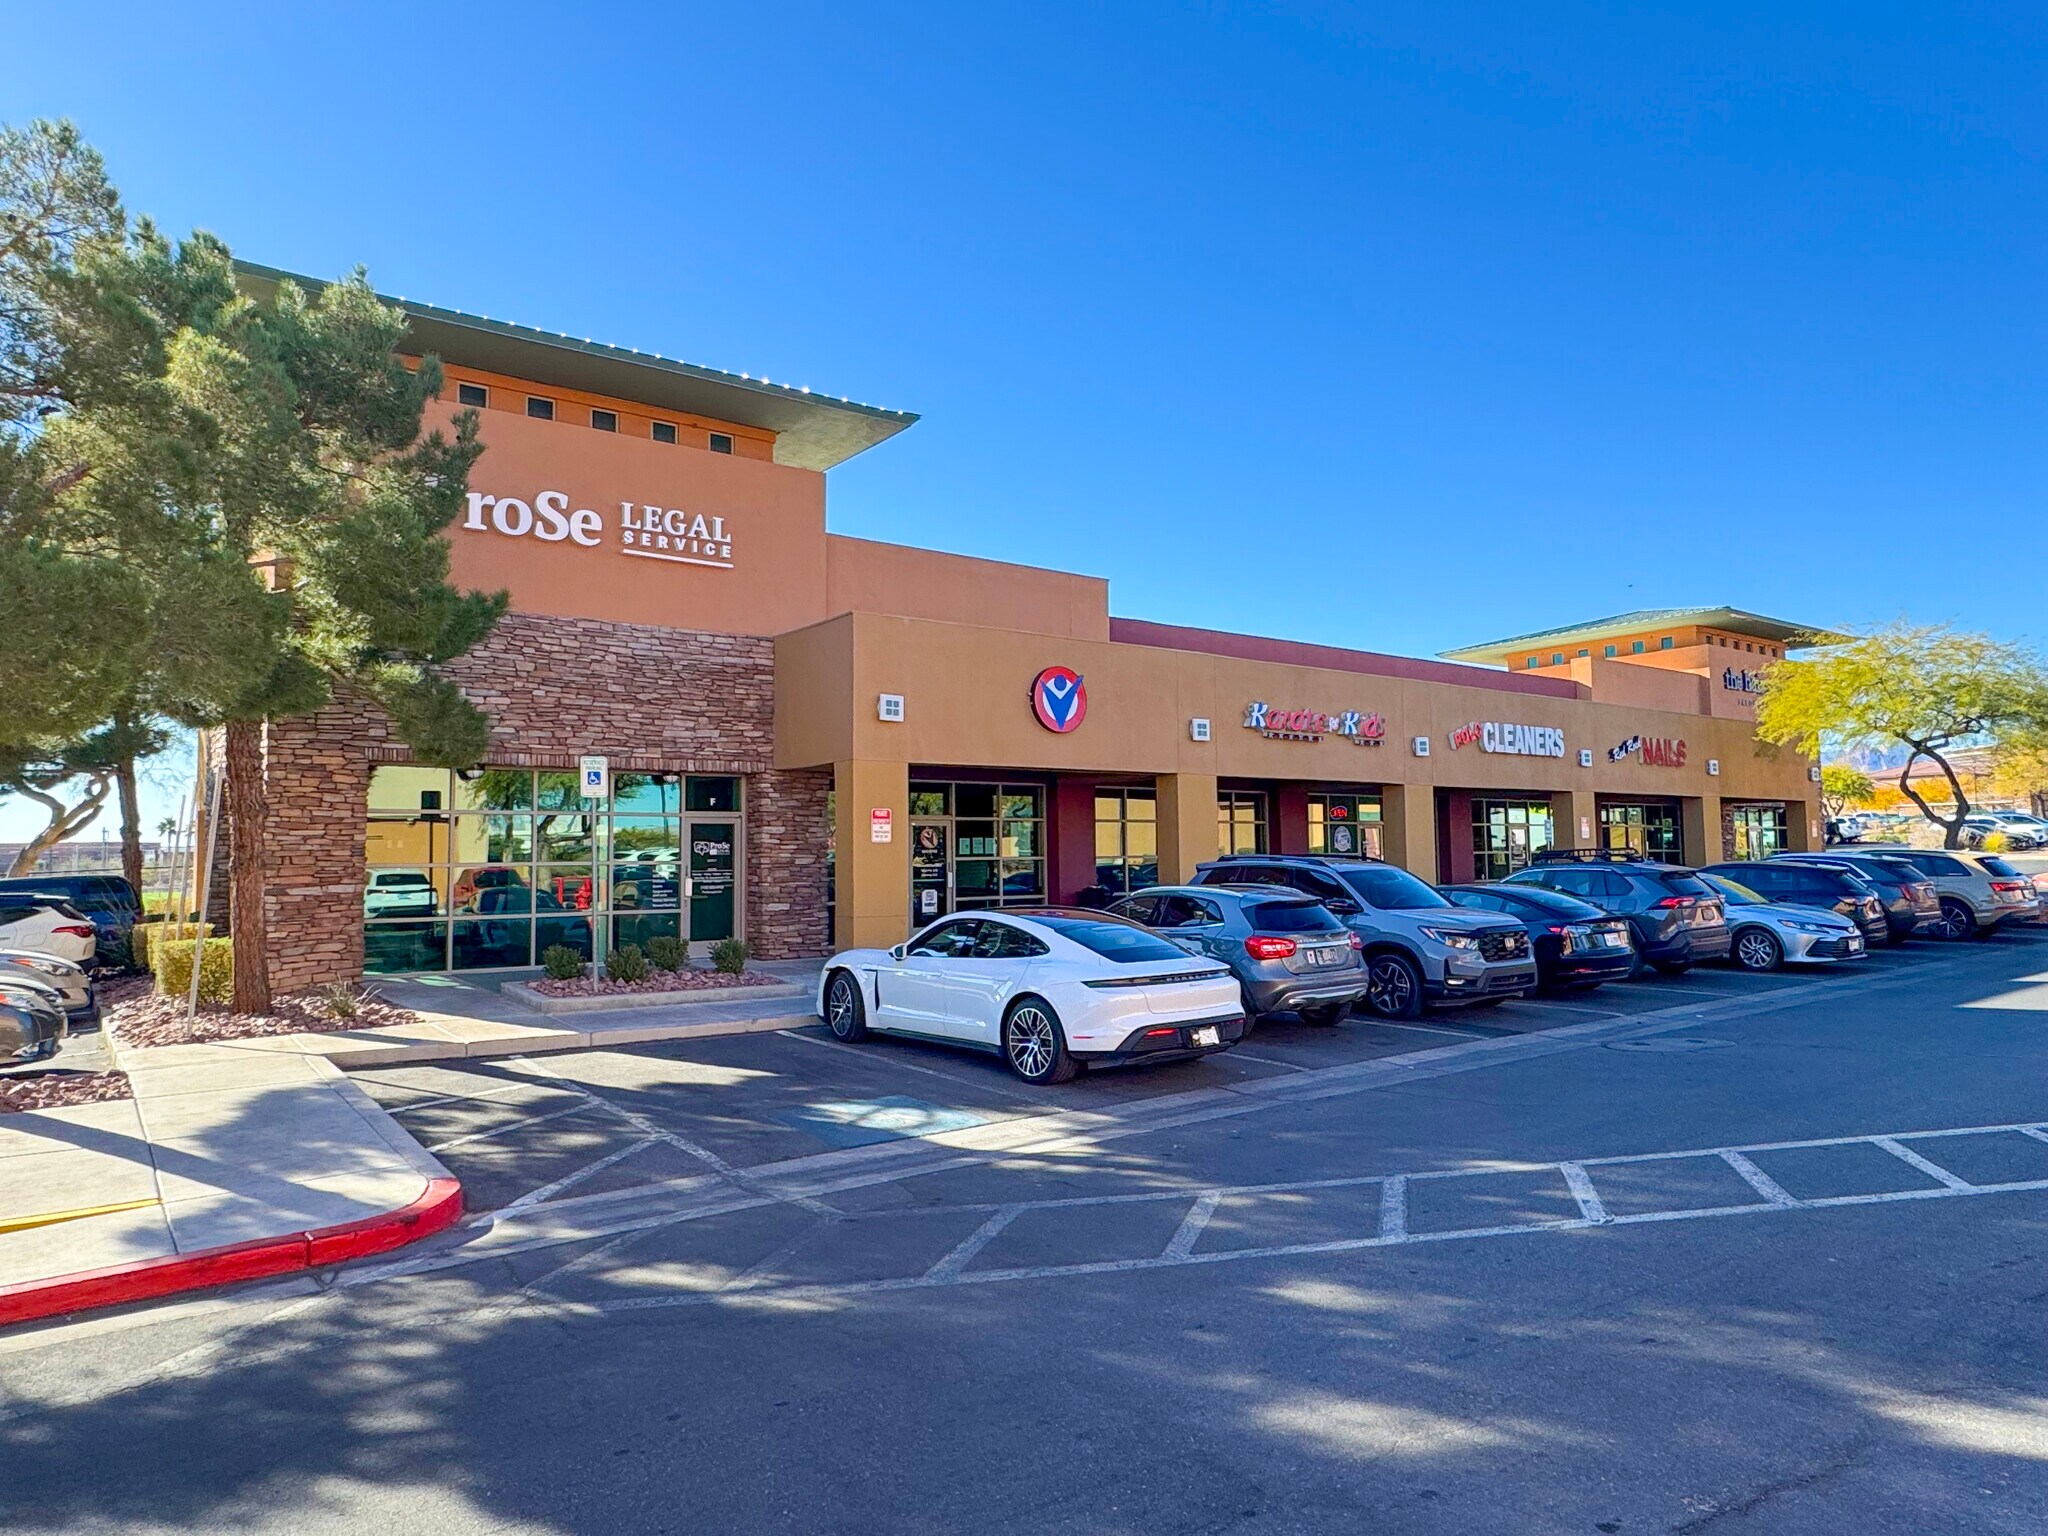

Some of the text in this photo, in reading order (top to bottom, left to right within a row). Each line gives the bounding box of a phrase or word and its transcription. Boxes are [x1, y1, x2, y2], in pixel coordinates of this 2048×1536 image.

[461, 489, 603, 547] roSe
[620, 501, 731, 543] LEGAL
[622, 530, 732, 558] SERVICE
[1245, 702, 1326, 733] Karate
[1451, 722, 1565, 757] POLO CLEANERS
[1639, 737, 1687, 768] NAILS
